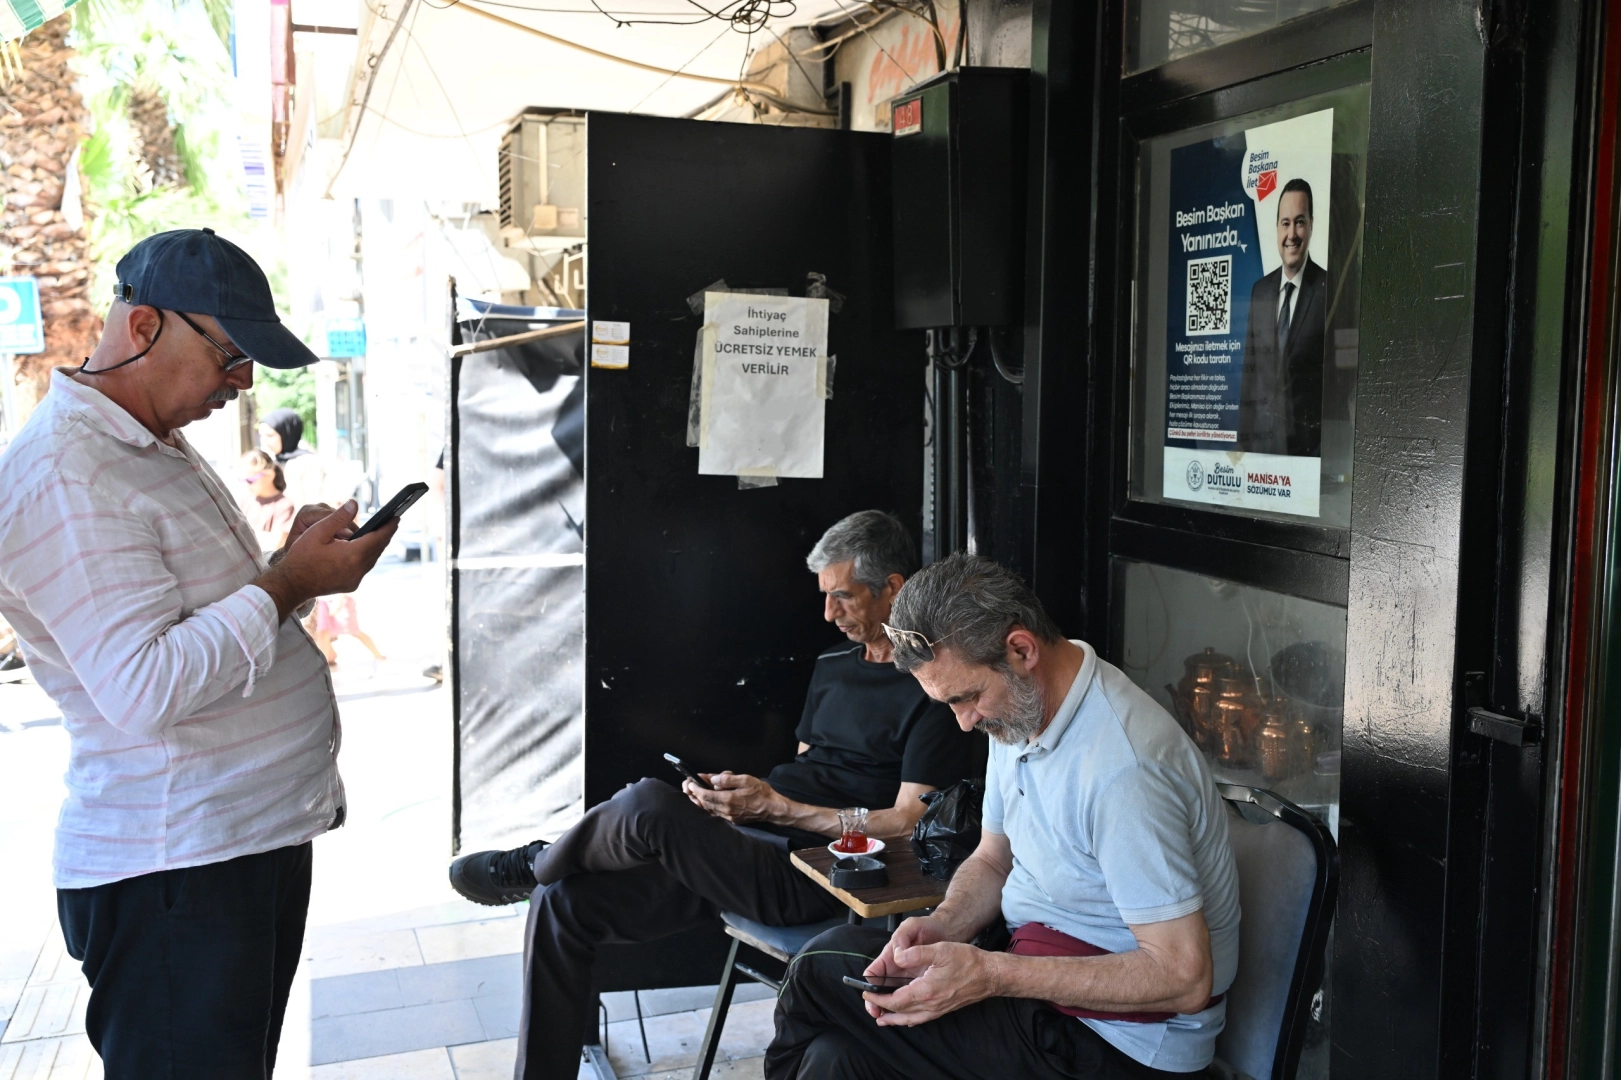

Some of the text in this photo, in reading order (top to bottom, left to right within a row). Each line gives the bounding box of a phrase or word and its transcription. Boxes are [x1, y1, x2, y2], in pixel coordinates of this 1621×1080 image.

[1250, 150, 1269, 162] Besim
[1248, 160, 1278, 174] Başkana
[1176, 201, 1245, 228] Besim Başkan
[748, 306, 787, 322] İhtiyaç
[733, 325, 800, 338] Sahiplerine
[714, 341, 817, 358] ÜCRETSİZ YEMEK
[1175, 340, 1241, 353] Mesajınızı iletmek için
[1183, 354, 1193, 366] QR
[1193, 353, 1209, 364] kodu
[742, 362, 789, 376] VERİLİR
[1214, 462, 1235, 474] Besim
[1207, 473, 1242, 488] DUTLULU
[1247, 472, 1291, 487] MANİSA'YA
[1247, 484, 1277, 497] SÖZÜMÜZ
[1277, 488, 1291, 498] VAR
